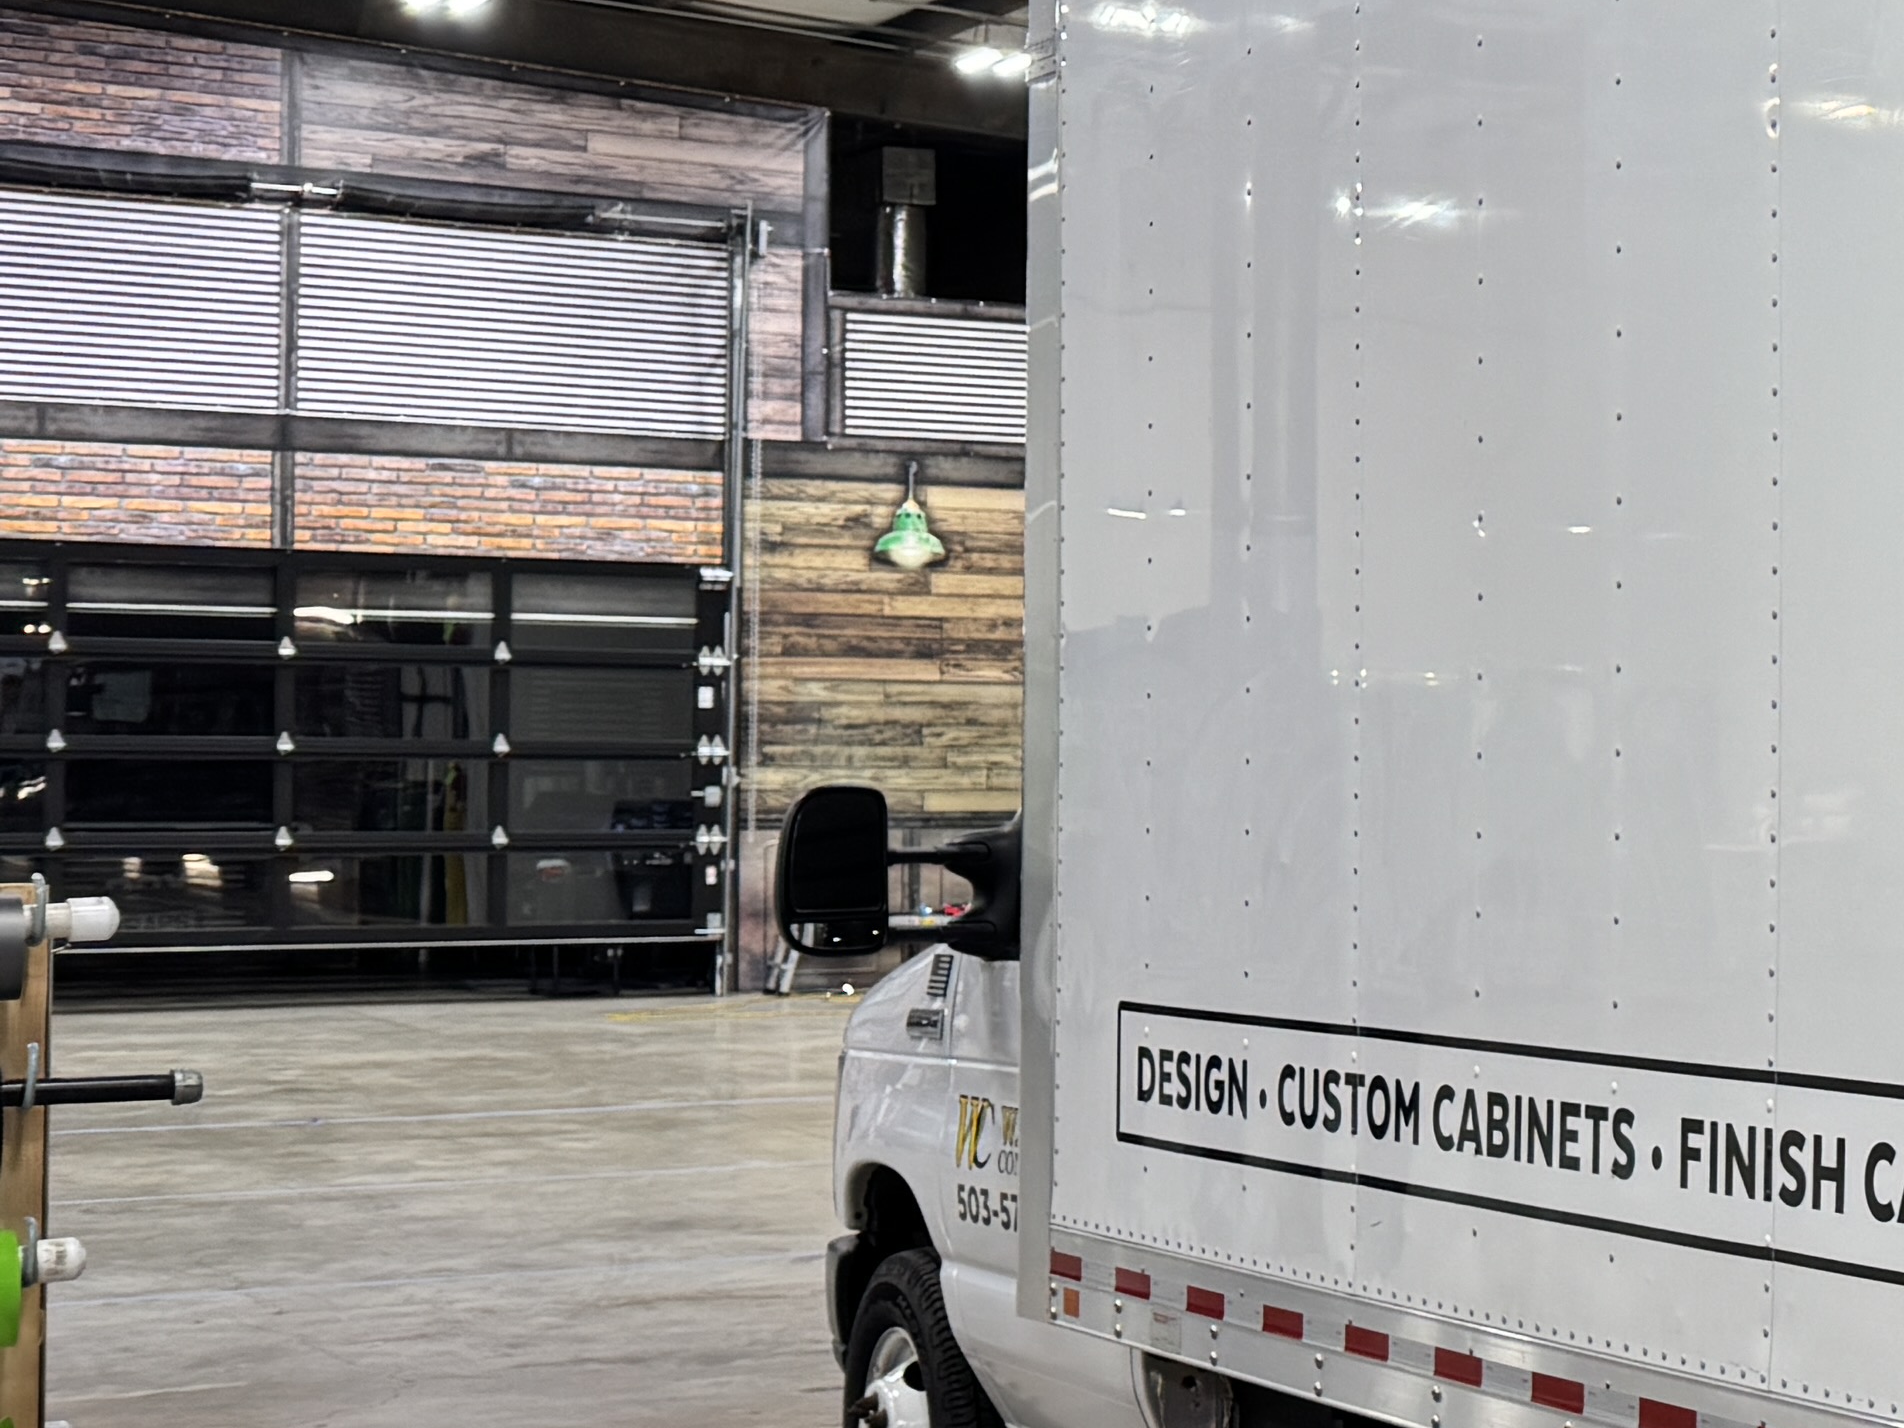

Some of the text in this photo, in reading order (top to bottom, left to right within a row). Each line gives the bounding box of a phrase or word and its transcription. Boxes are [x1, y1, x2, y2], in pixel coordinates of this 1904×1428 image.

[1001, 1105, 1019, 1147] W
[1135, 1045, 1249, 1121] DESIGN
[1276, 1062, 1421, 1147] CUSTOM
[1431, 1083, 1637, 1181] CABINETS
[1679, 1116, 1847, 1215] FINISH
